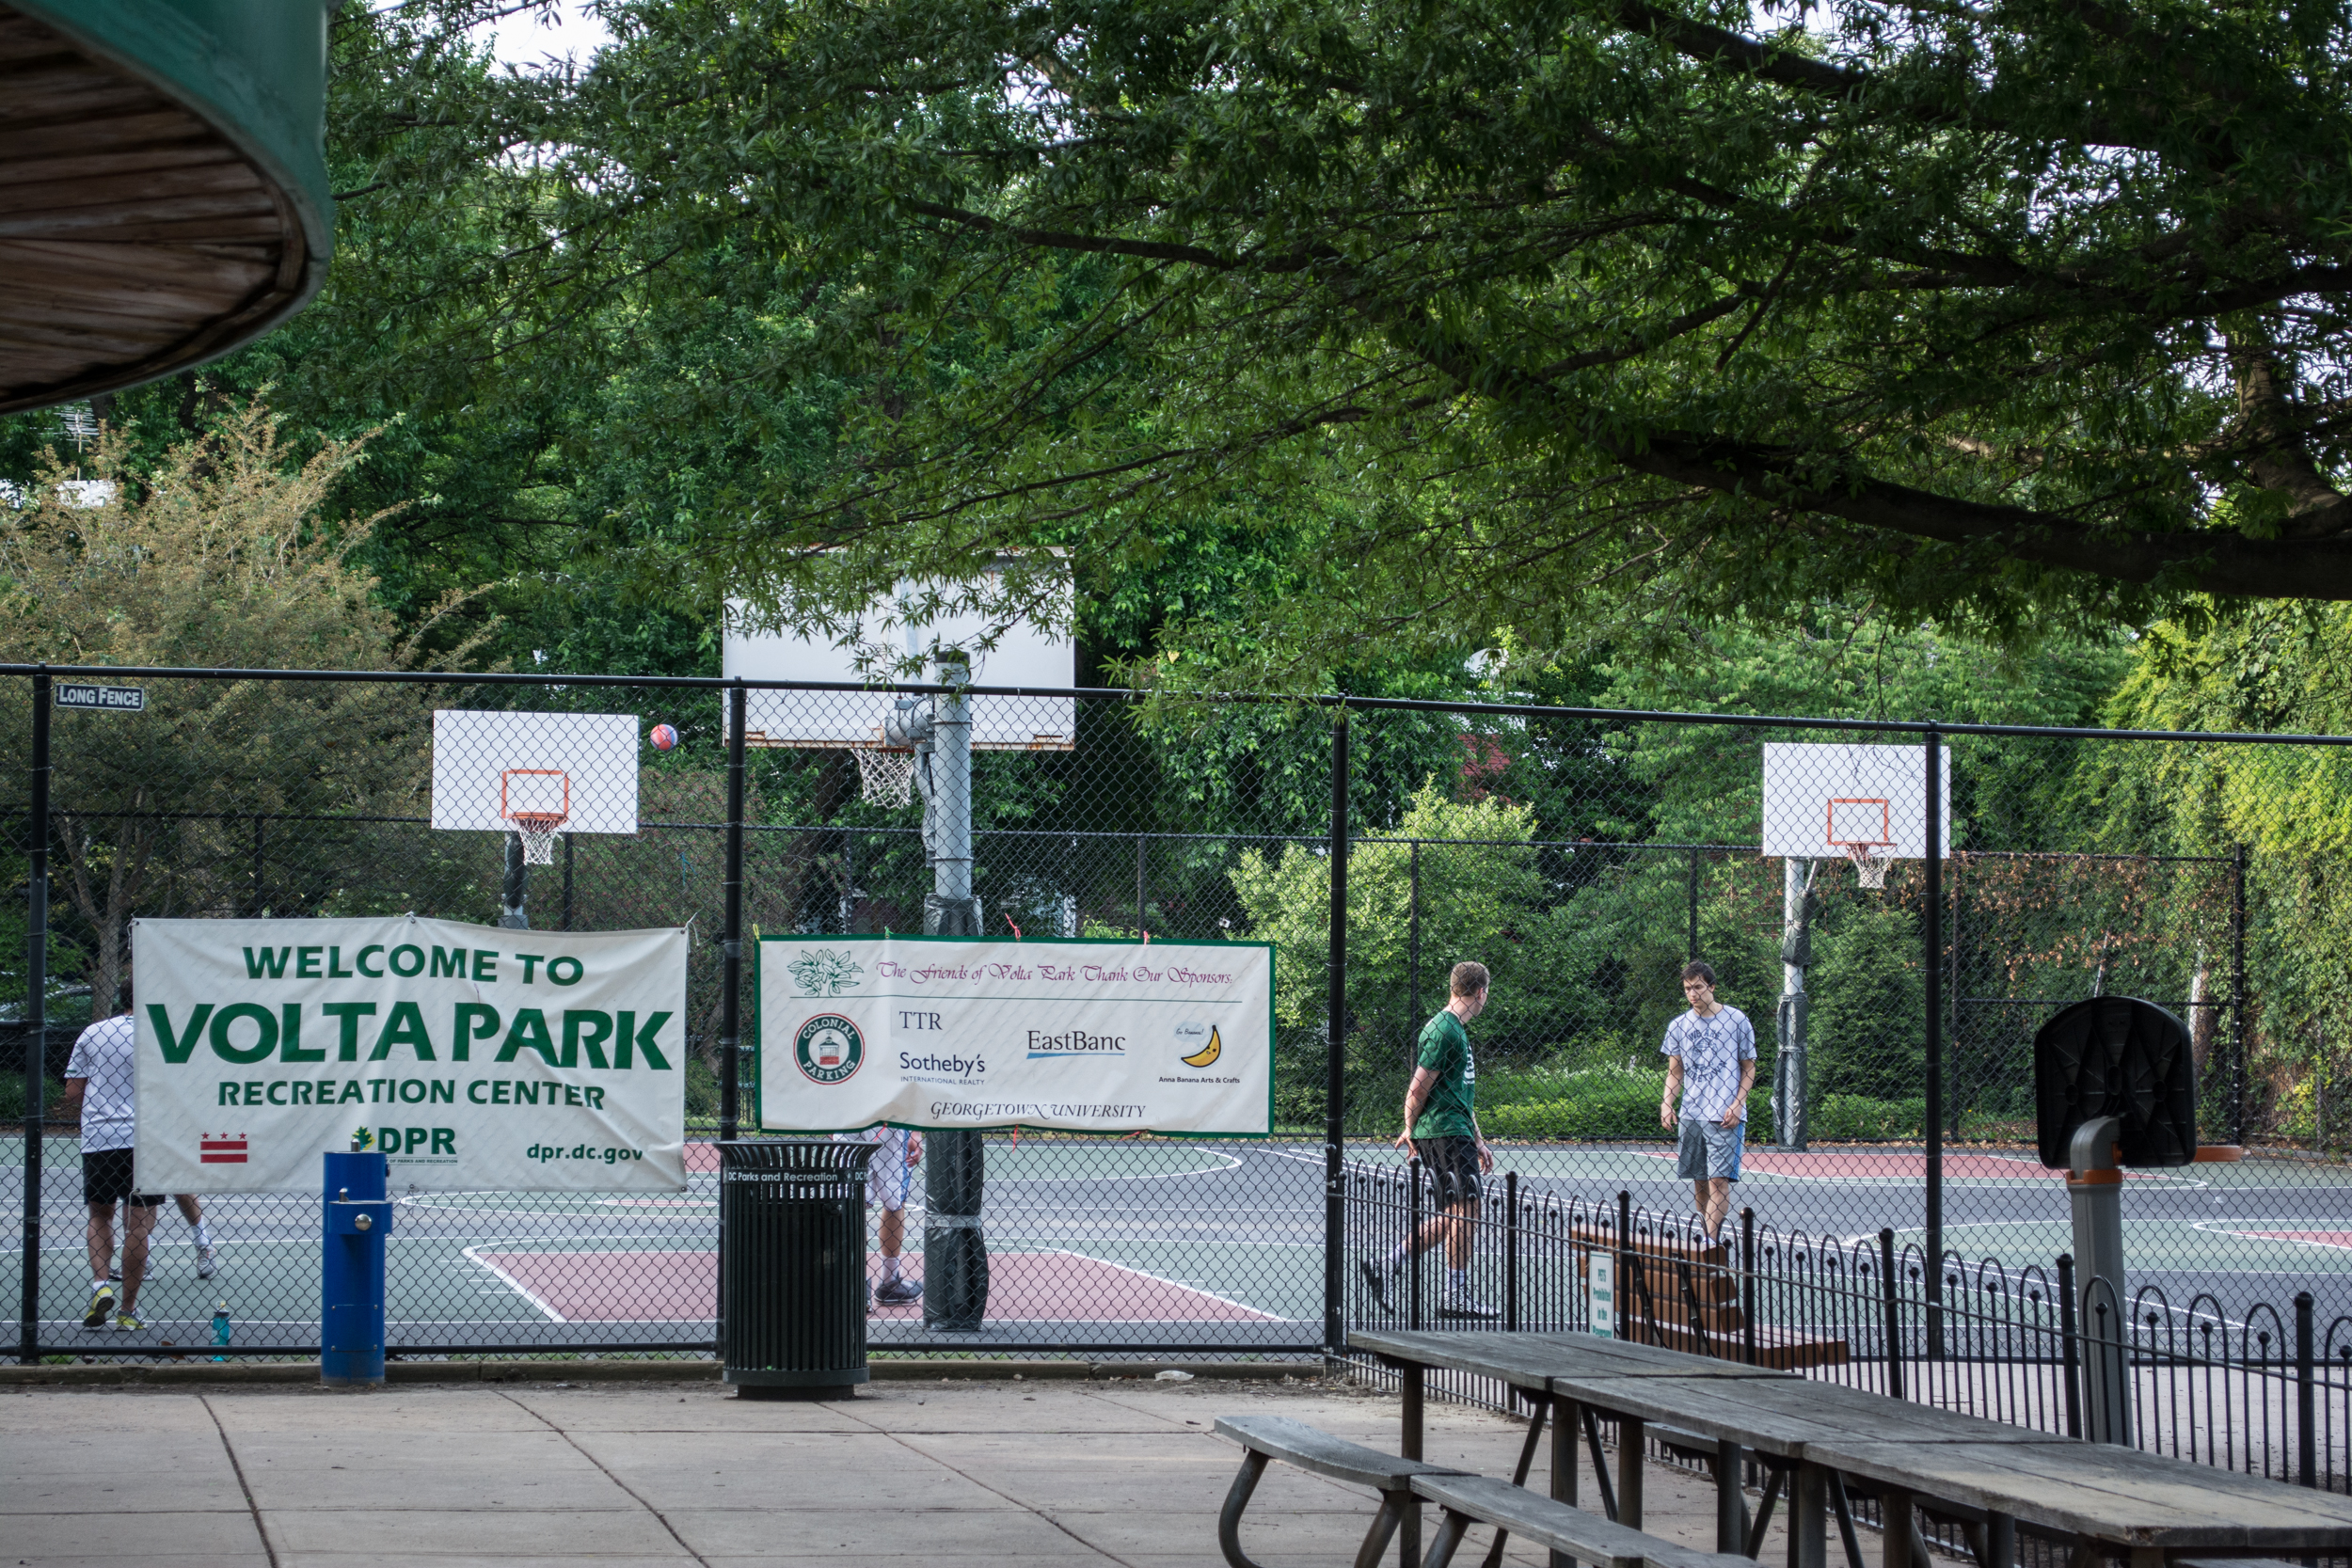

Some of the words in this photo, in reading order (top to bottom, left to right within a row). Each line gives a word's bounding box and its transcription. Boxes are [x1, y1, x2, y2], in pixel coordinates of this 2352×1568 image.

[58, 685, 96, 705] LONG
[98, 687, 140, 706] FENCE
[242, 943, 500, 982] WELCOME
[515, 953, 584, 987] TO
[876, 961, 906, 978] The
[909, 963, 968, 985] Friends
[971, 965, 987, 985] of
[988, 962, 1033, 981] Volta
[1037, 963, 1075, 982] Park
[1079, 964, 1129, 983] Thank
[1132, 965, 1164, 983] Our
[802, 1018, 854, 1039] COLONIAL
[898, 1010, 944, 1031] TTR
[145, 1001, 437, 1065] VOLTA
[452, 1002, 674, 1070] PARK
[1026, 1030, 1126, 1051] EastBanc
[803, 1061, 856, 1081] PARKING
[899, 1052, 986, 1077] Sotheby's
[900, 1075, 957, 1085] INTERNATIONAL
[218, 1079, 455, 1106] RECREATION
[467, 1080, 605, 1110] CENTER
[930, 1101, 1051, 1120] GEORGETOWN
[1050, 1104, 1147, 1117] UNIVERSITY
[378, 1127, 456, 1155] DPR
[526, 1143, 644, 1165] dpr.dc.gov
[728, 1171, 737, 1181] DC
[738, 1171, 759, 1181] Parks
[760, 1171, 781, 1182] and
[783, 1172, 838, 1182] Recreation
[854, 1171, 864, 1181] DC
